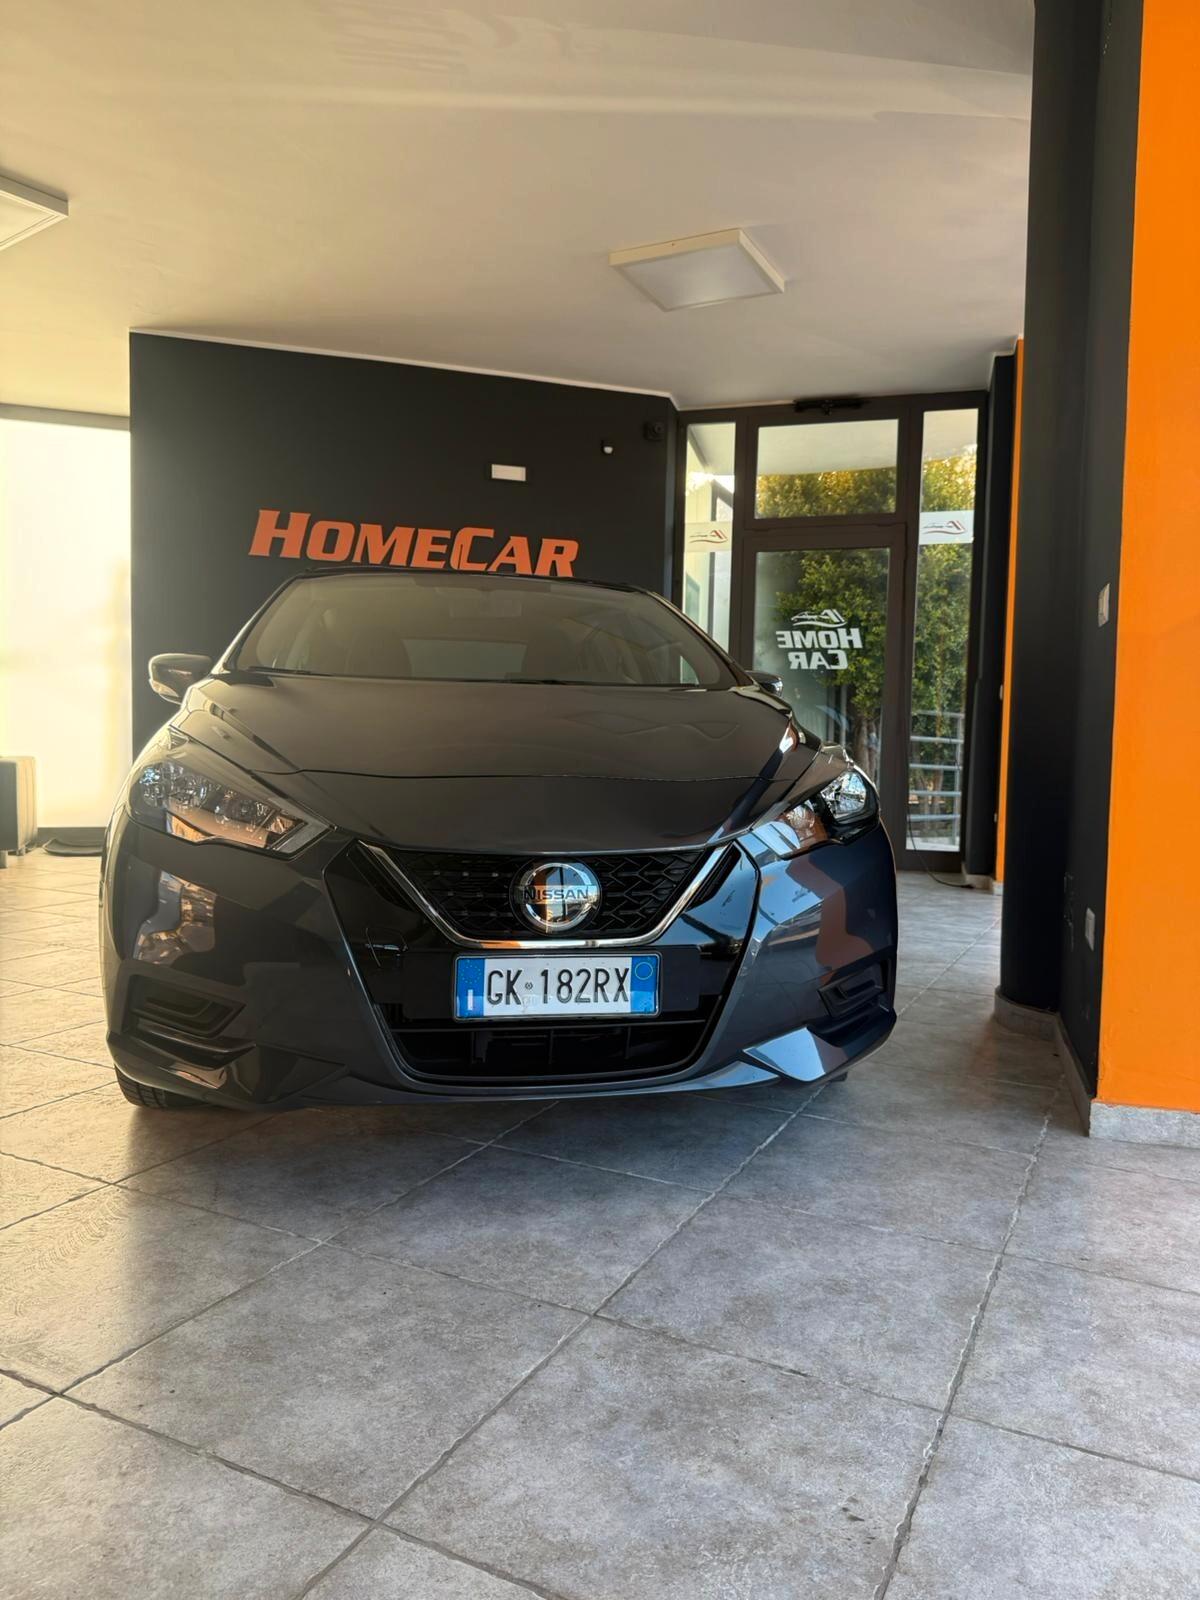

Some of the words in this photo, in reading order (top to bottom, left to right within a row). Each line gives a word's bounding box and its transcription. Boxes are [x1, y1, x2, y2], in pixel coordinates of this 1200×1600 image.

[523, 889, 588, 900] NISSAN
[487, 969, 522, 1005] GK
[540, 968, 629, 1004] 182RX
